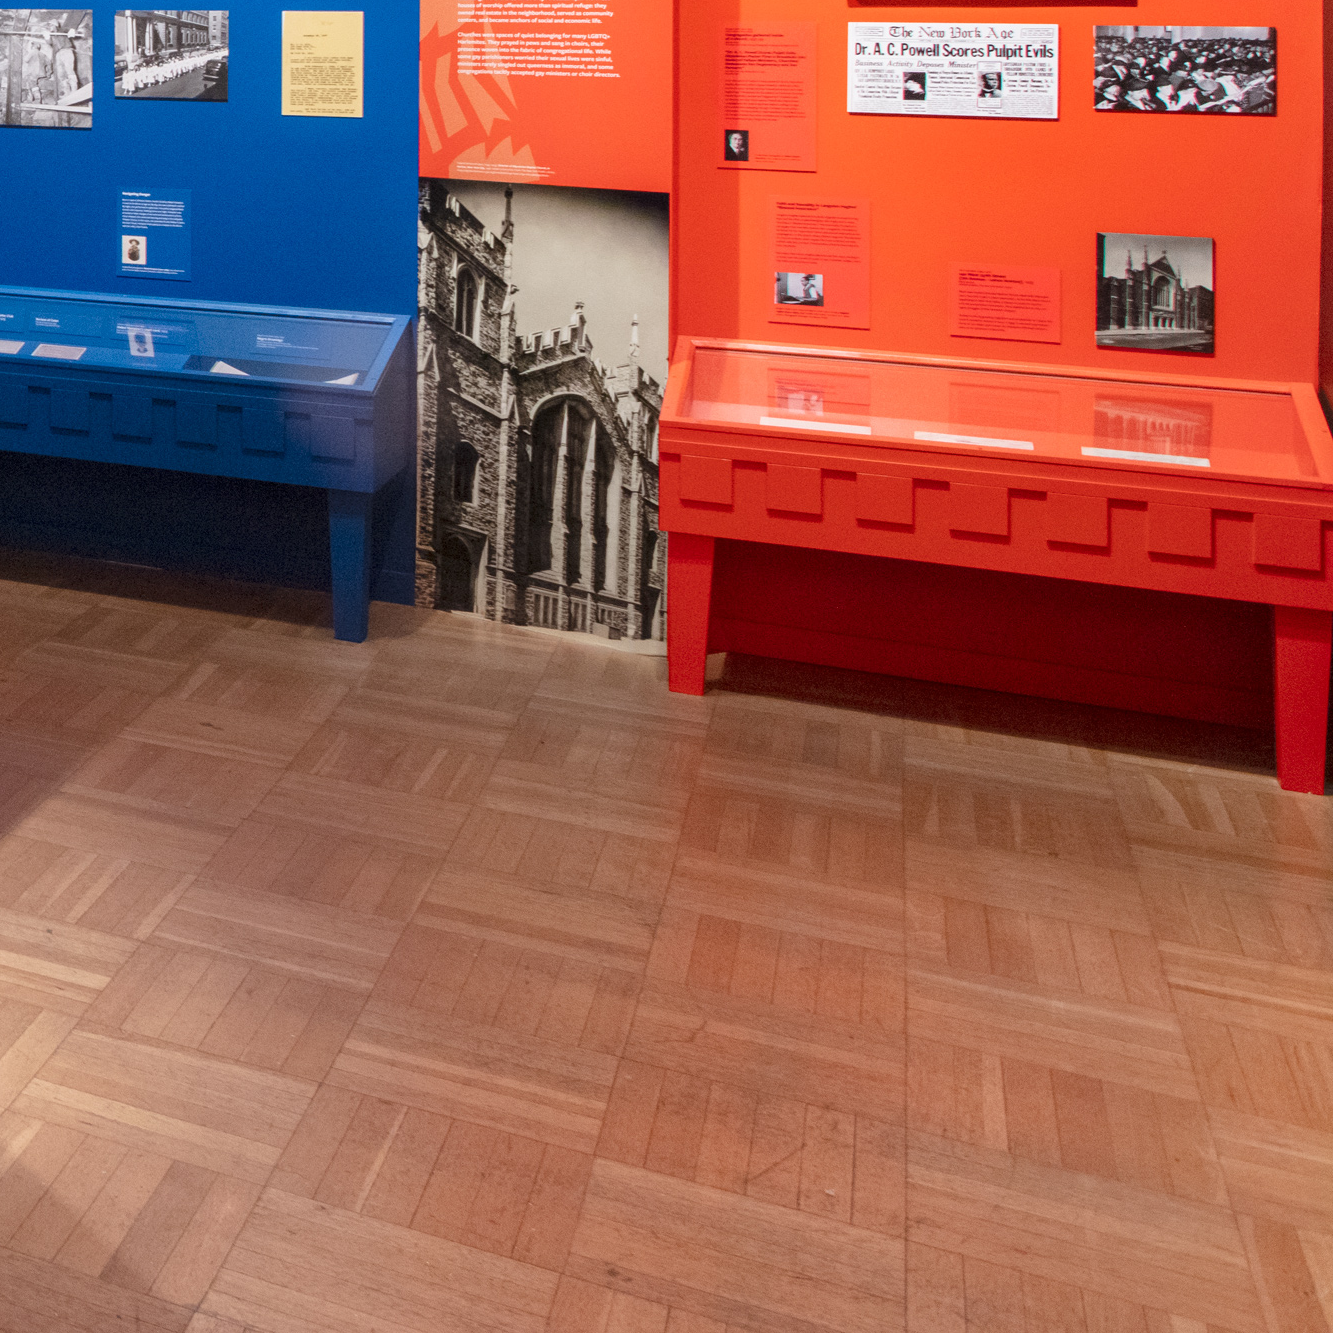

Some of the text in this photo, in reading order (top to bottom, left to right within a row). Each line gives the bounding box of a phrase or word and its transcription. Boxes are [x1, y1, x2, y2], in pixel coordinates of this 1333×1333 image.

[889, 26, 1014, 39] The New York Age
[855, 43, 1054, 60] Dr. A. C. Powell Scores Pulpit Evils
[887, 60, 913, 68] Activity
[948, 61, 977, 69] Minister
